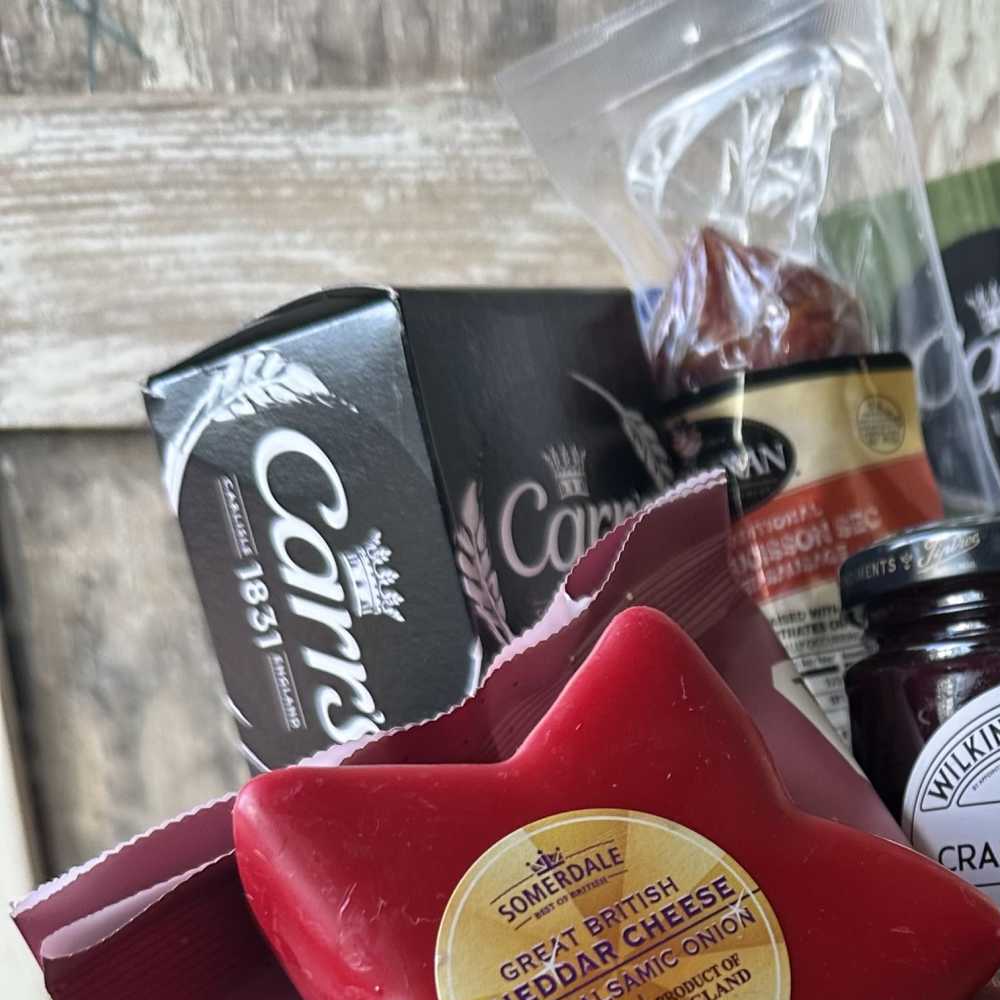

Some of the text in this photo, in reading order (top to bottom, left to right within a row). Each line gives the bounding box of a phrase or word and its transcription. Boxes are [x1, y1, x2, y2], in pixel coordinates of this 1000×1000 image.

[234, 562, 285, 649] 1831
[271, 653, 302, 729] ENGLAND
[497, 845, 627, 924] SOMERDALE
[569, 876, 609, 900] BRITISH
[621, 874, 737, 948] CHEESE
[499, 875, 681, 984] GREAT BRITISH
[681, 907, 757, 957] ONION
[721, 951, 744, 974] OF
